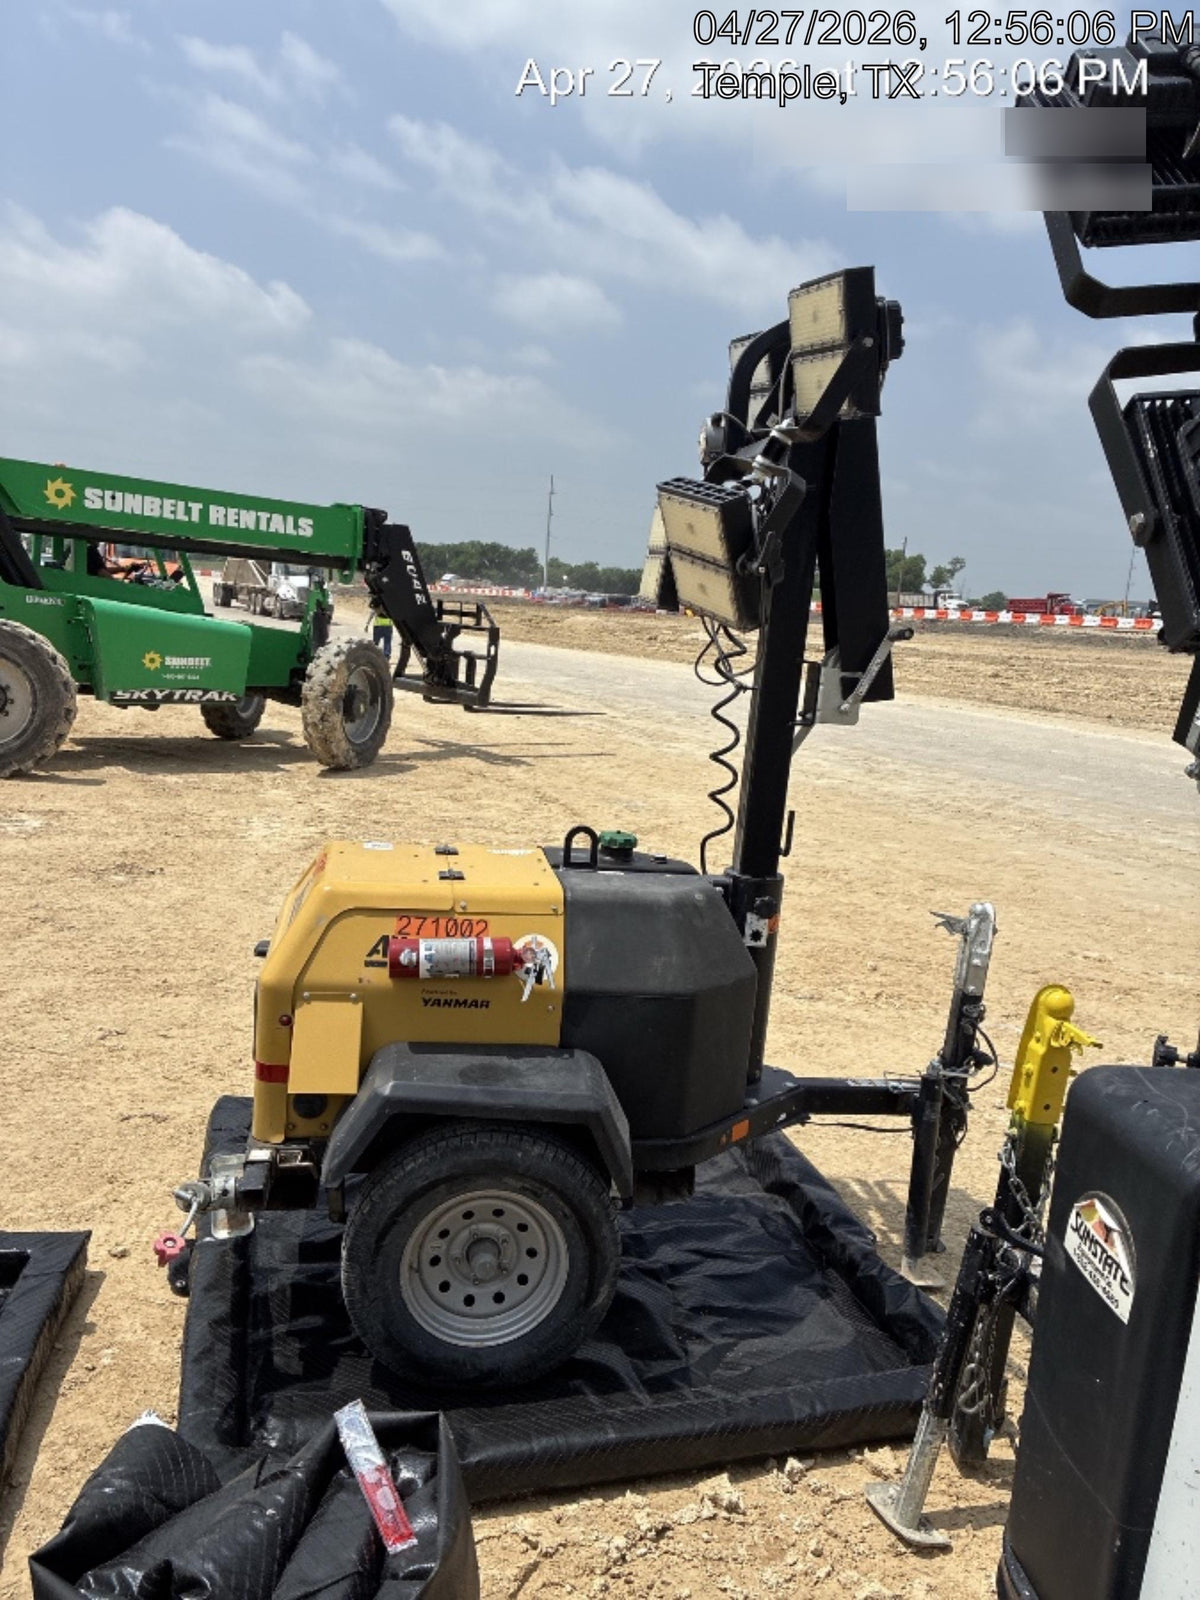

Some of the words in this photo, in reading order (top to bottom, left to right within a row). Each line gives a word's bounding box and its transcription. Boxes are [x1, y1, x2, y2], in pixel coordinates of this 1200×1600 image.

[84, 487, 203, 523] SUNBELT
[209, 504, 314, 538] RENTALS
[113, 688, 237, 702] SKYTRAK
[397, 915, 488, 938] 271002
[421, 997, 490, 1010] YANMAR
